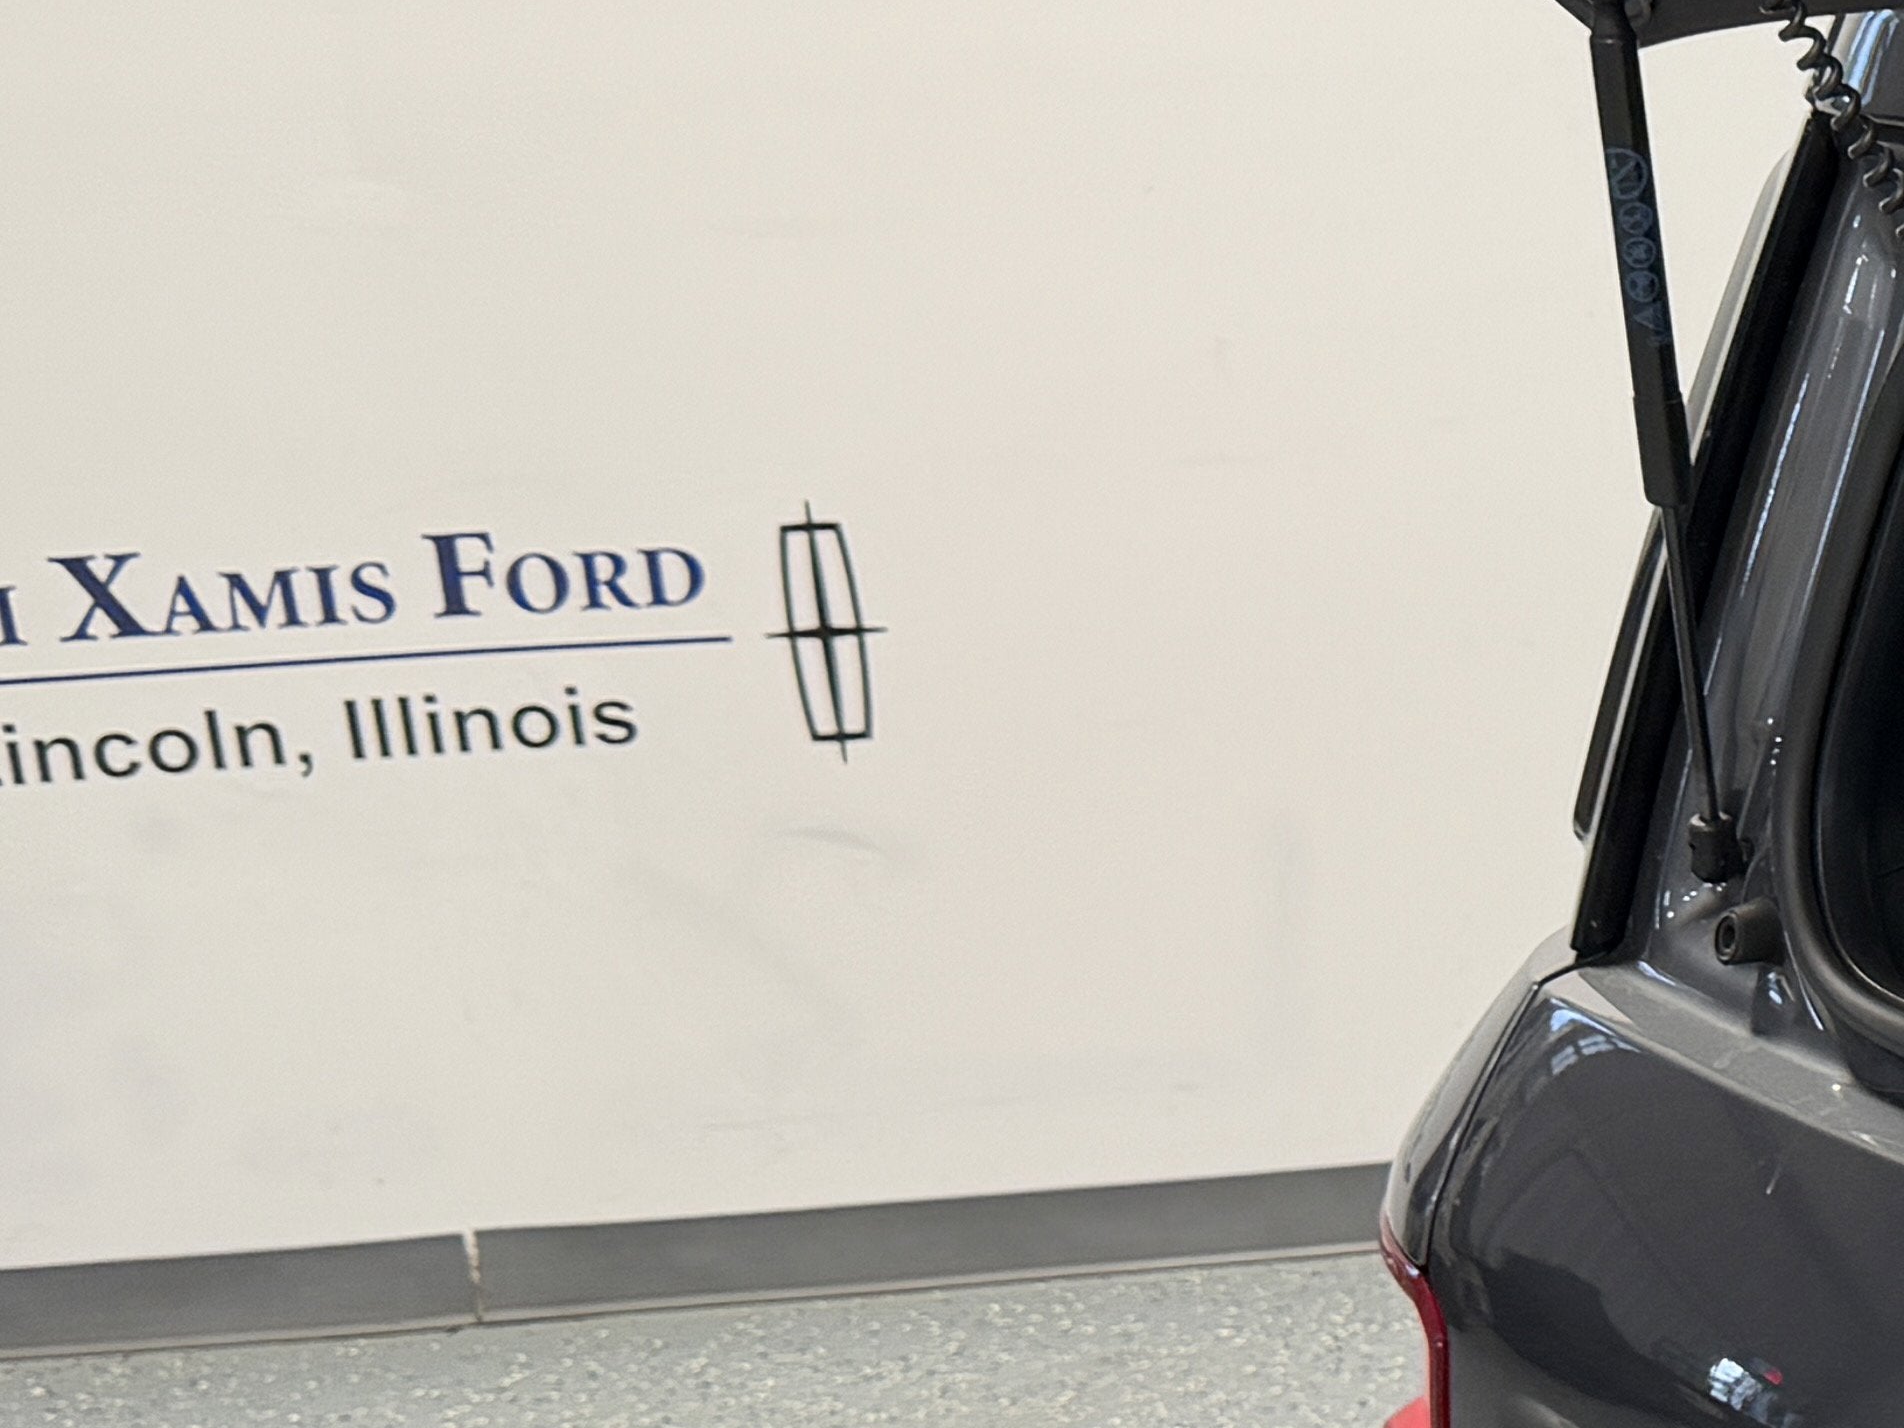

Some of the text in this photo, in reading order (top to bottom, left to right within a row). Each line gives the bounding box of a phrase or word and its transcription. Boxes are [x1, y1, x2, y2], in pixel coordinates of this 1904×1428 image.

[47, 551, 396, 644] XAMIS
[421, 532, 706, 620] FORD
[0, 685, 638, 784] incoln, Illinois
